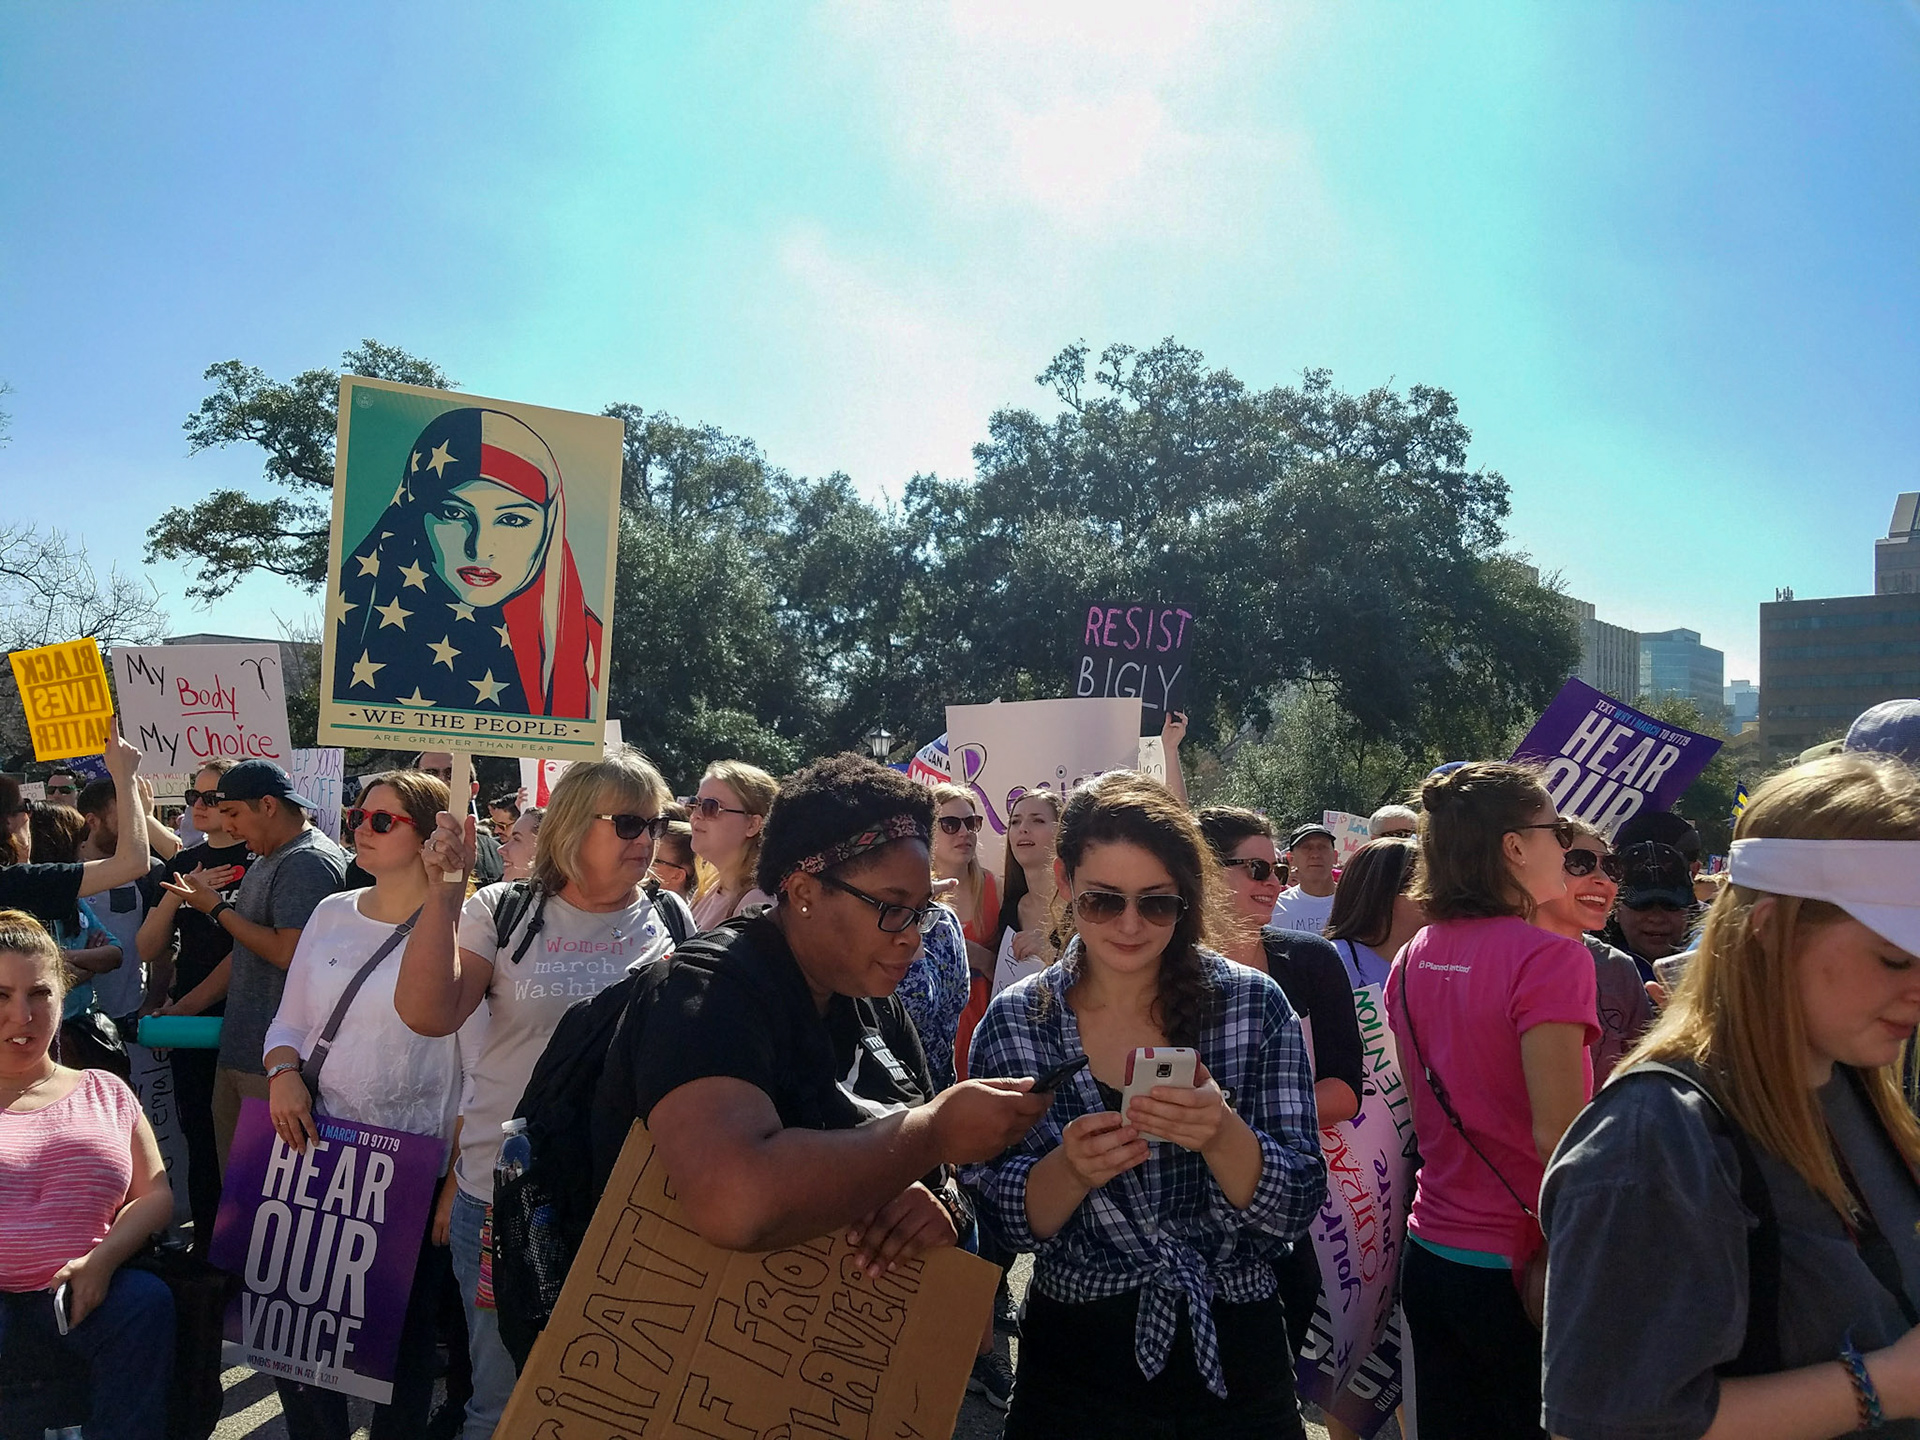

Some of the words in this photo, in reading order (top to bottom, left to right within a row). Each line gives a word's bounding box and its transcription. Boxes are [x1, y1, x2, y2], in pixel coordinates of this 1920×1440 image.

[1084, 606, 1192, 651] RESIST
[126, 653, 165, 695] My
[1077, 655, 1182, 711] BIGLY
[176, 674, 236, 720] Body
[186, 724, 279, 759] Choice
[362, 708, 405, 725] WE
[414, 713, 465, 730] THE
[473, 717, 568, 737] PEOPLE
[1595, 699, 1616, 715] TEXT
[1613, 708, 1633, 724] WHY
[1659, 728, 1671, 740] TO
[139, 722, 180, 766] My
[373, 734, 400, 742] ARE
[408, 736, 472, 747] GREATER
[478, 740, 514, 750] THAN
[521, 743, 555, 752] FEAR
[1560, 710, 1681, 793] HEAR
[311, 776, 336, 808] OFF
[1544, 757, 1644, 844] OUR
[1291, 917, 1323, 931] IMPE
[534, 957, 618, 974] march
[325, 1124, 357, 1143] MARCH
[357, 1131, 370, 1146] TO
[370, 1134, 401, 1152] 97779
[261, 1131, 395, 1224] HEAR
[1320, 1125, 1378, 1283] OUTRAG
[244, 1199, 378, 1318] OUR
[706, 1235, 836, 1379] FRO
[242, 1291, 362, 1374] VOICE
